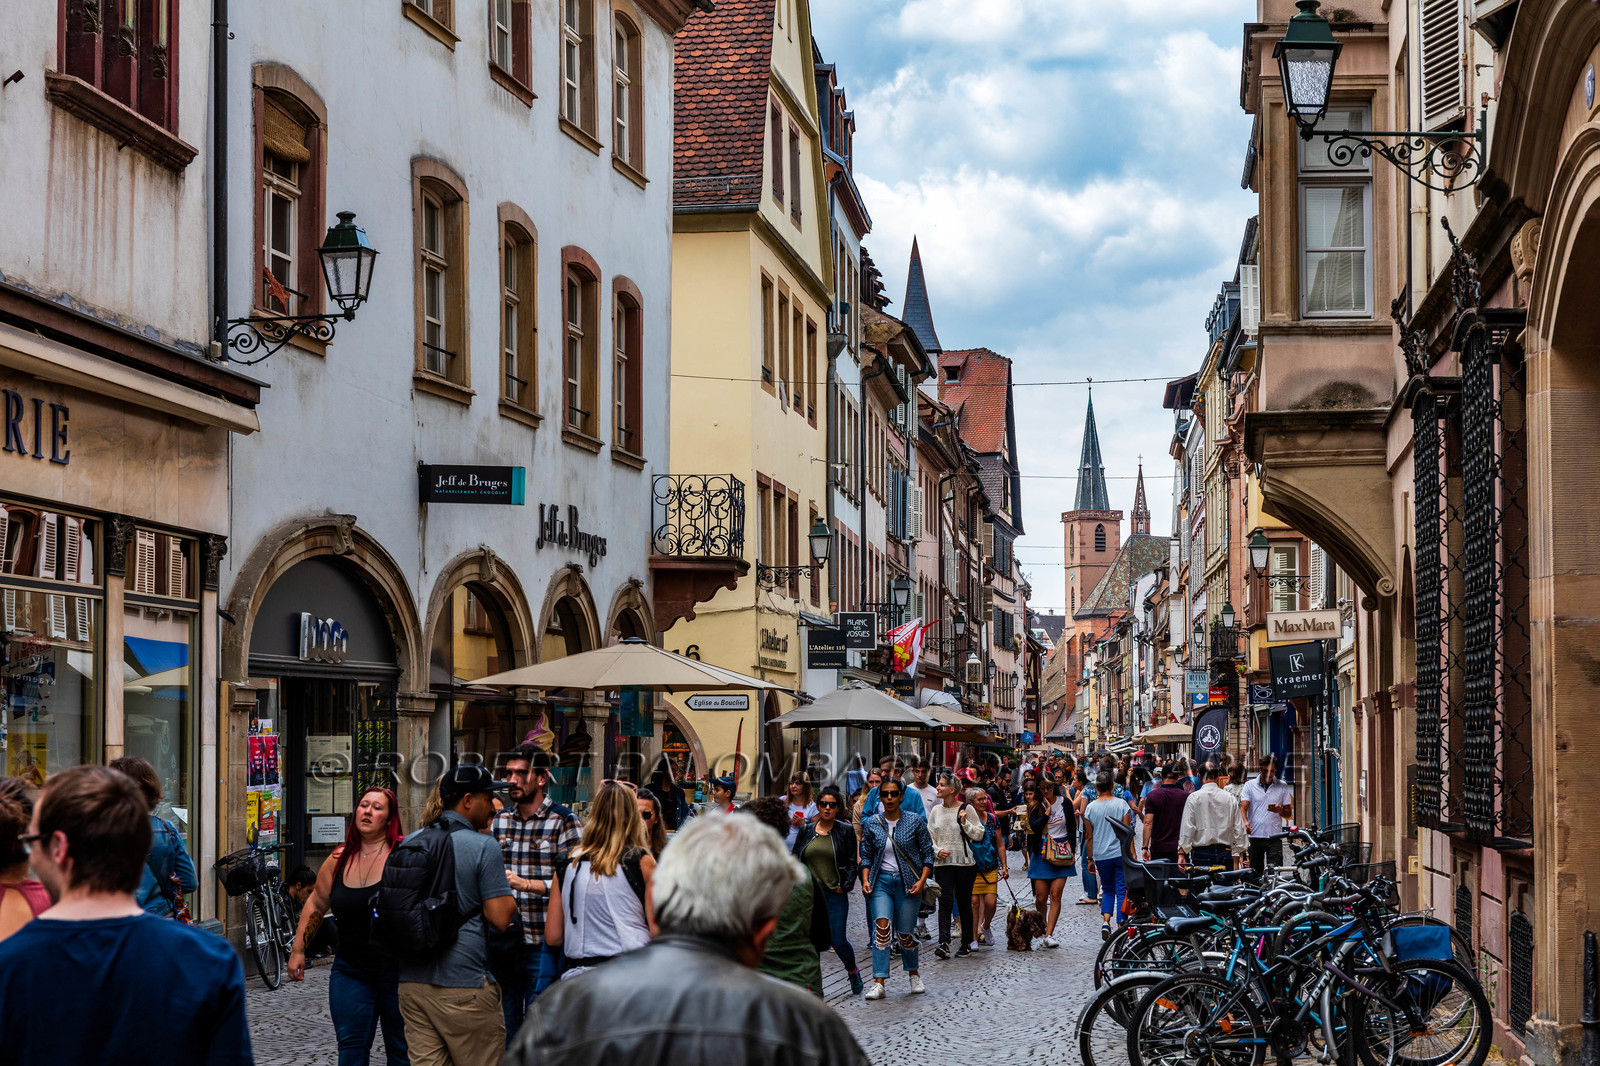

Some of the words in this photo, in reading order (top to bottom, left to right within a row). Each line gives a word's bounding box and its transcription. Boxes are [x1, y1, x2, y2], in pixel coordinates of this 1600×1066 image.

[2, 389, 70, 465] RIE
[435, 474, 457, 488] Jeff
[458, 478, 467, 486] de
[468, 473, 508, 490] Bruges
[537, 503, 560, 550] Jeff
[559, 520, 569, 547] de
[568, 504, 607, 568] Bruges
[847, 618, 868, 627] BLANC
[1273, 617, 1336, 634] MaxMara
[671, 644, 701, 662] 6
[1276, 673, 1323, 686] Kraemer
[693, 699, 713, 707] Eglise
